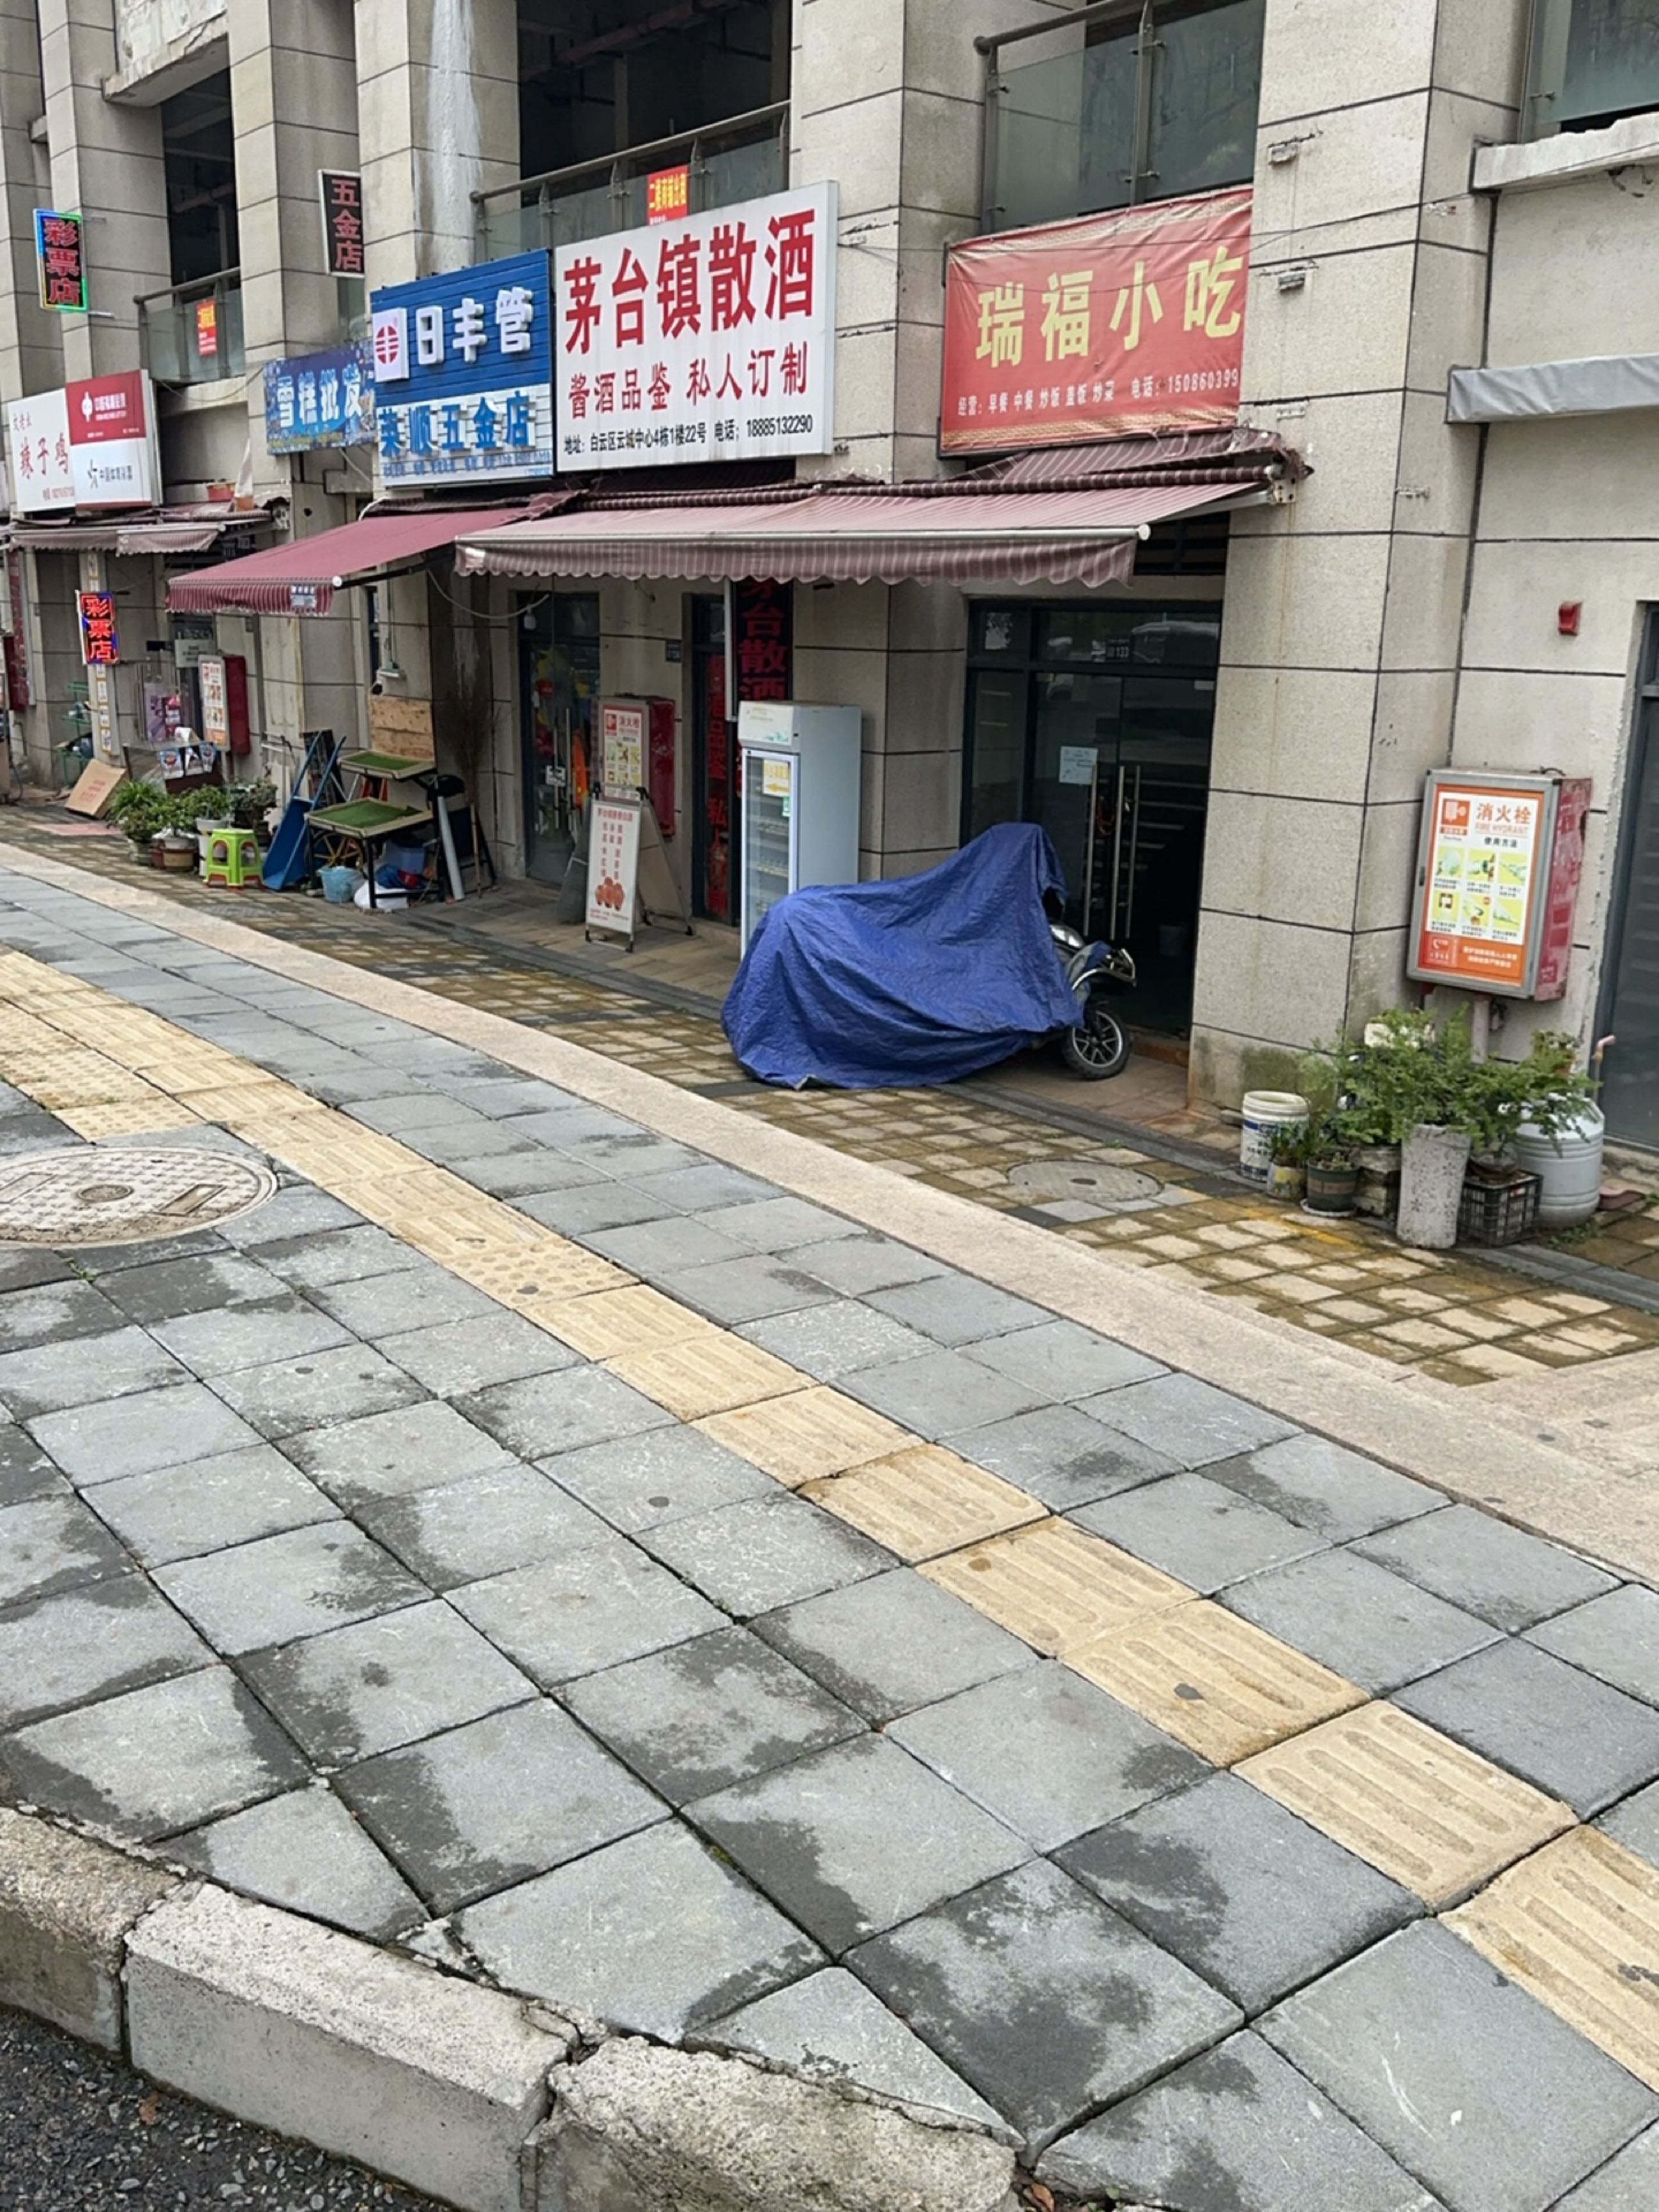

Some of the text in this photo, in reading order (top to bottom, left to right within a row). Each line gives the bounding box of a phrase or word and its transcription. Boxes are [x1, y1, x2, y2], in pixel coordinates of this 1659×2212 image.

[44, 218, 80, 305] 彩票店
[331, 179, 362, 271] 五金店
[564, 209, 815, 355] 茅台镇散酒
[976, 246, 1242, 367] 瑞福小吃
[416, 287, 533, 364] 日丰管
[277, 362, 362, 428] 雪糕批发
[568, 341, 808, 420] 酱酒品鉴 私人订制
[86, 598, 113, 659] 彩票店
[1476, 802, 1531, 824] 消火栓
[1484, 836, 1518, 849] 使用方法
